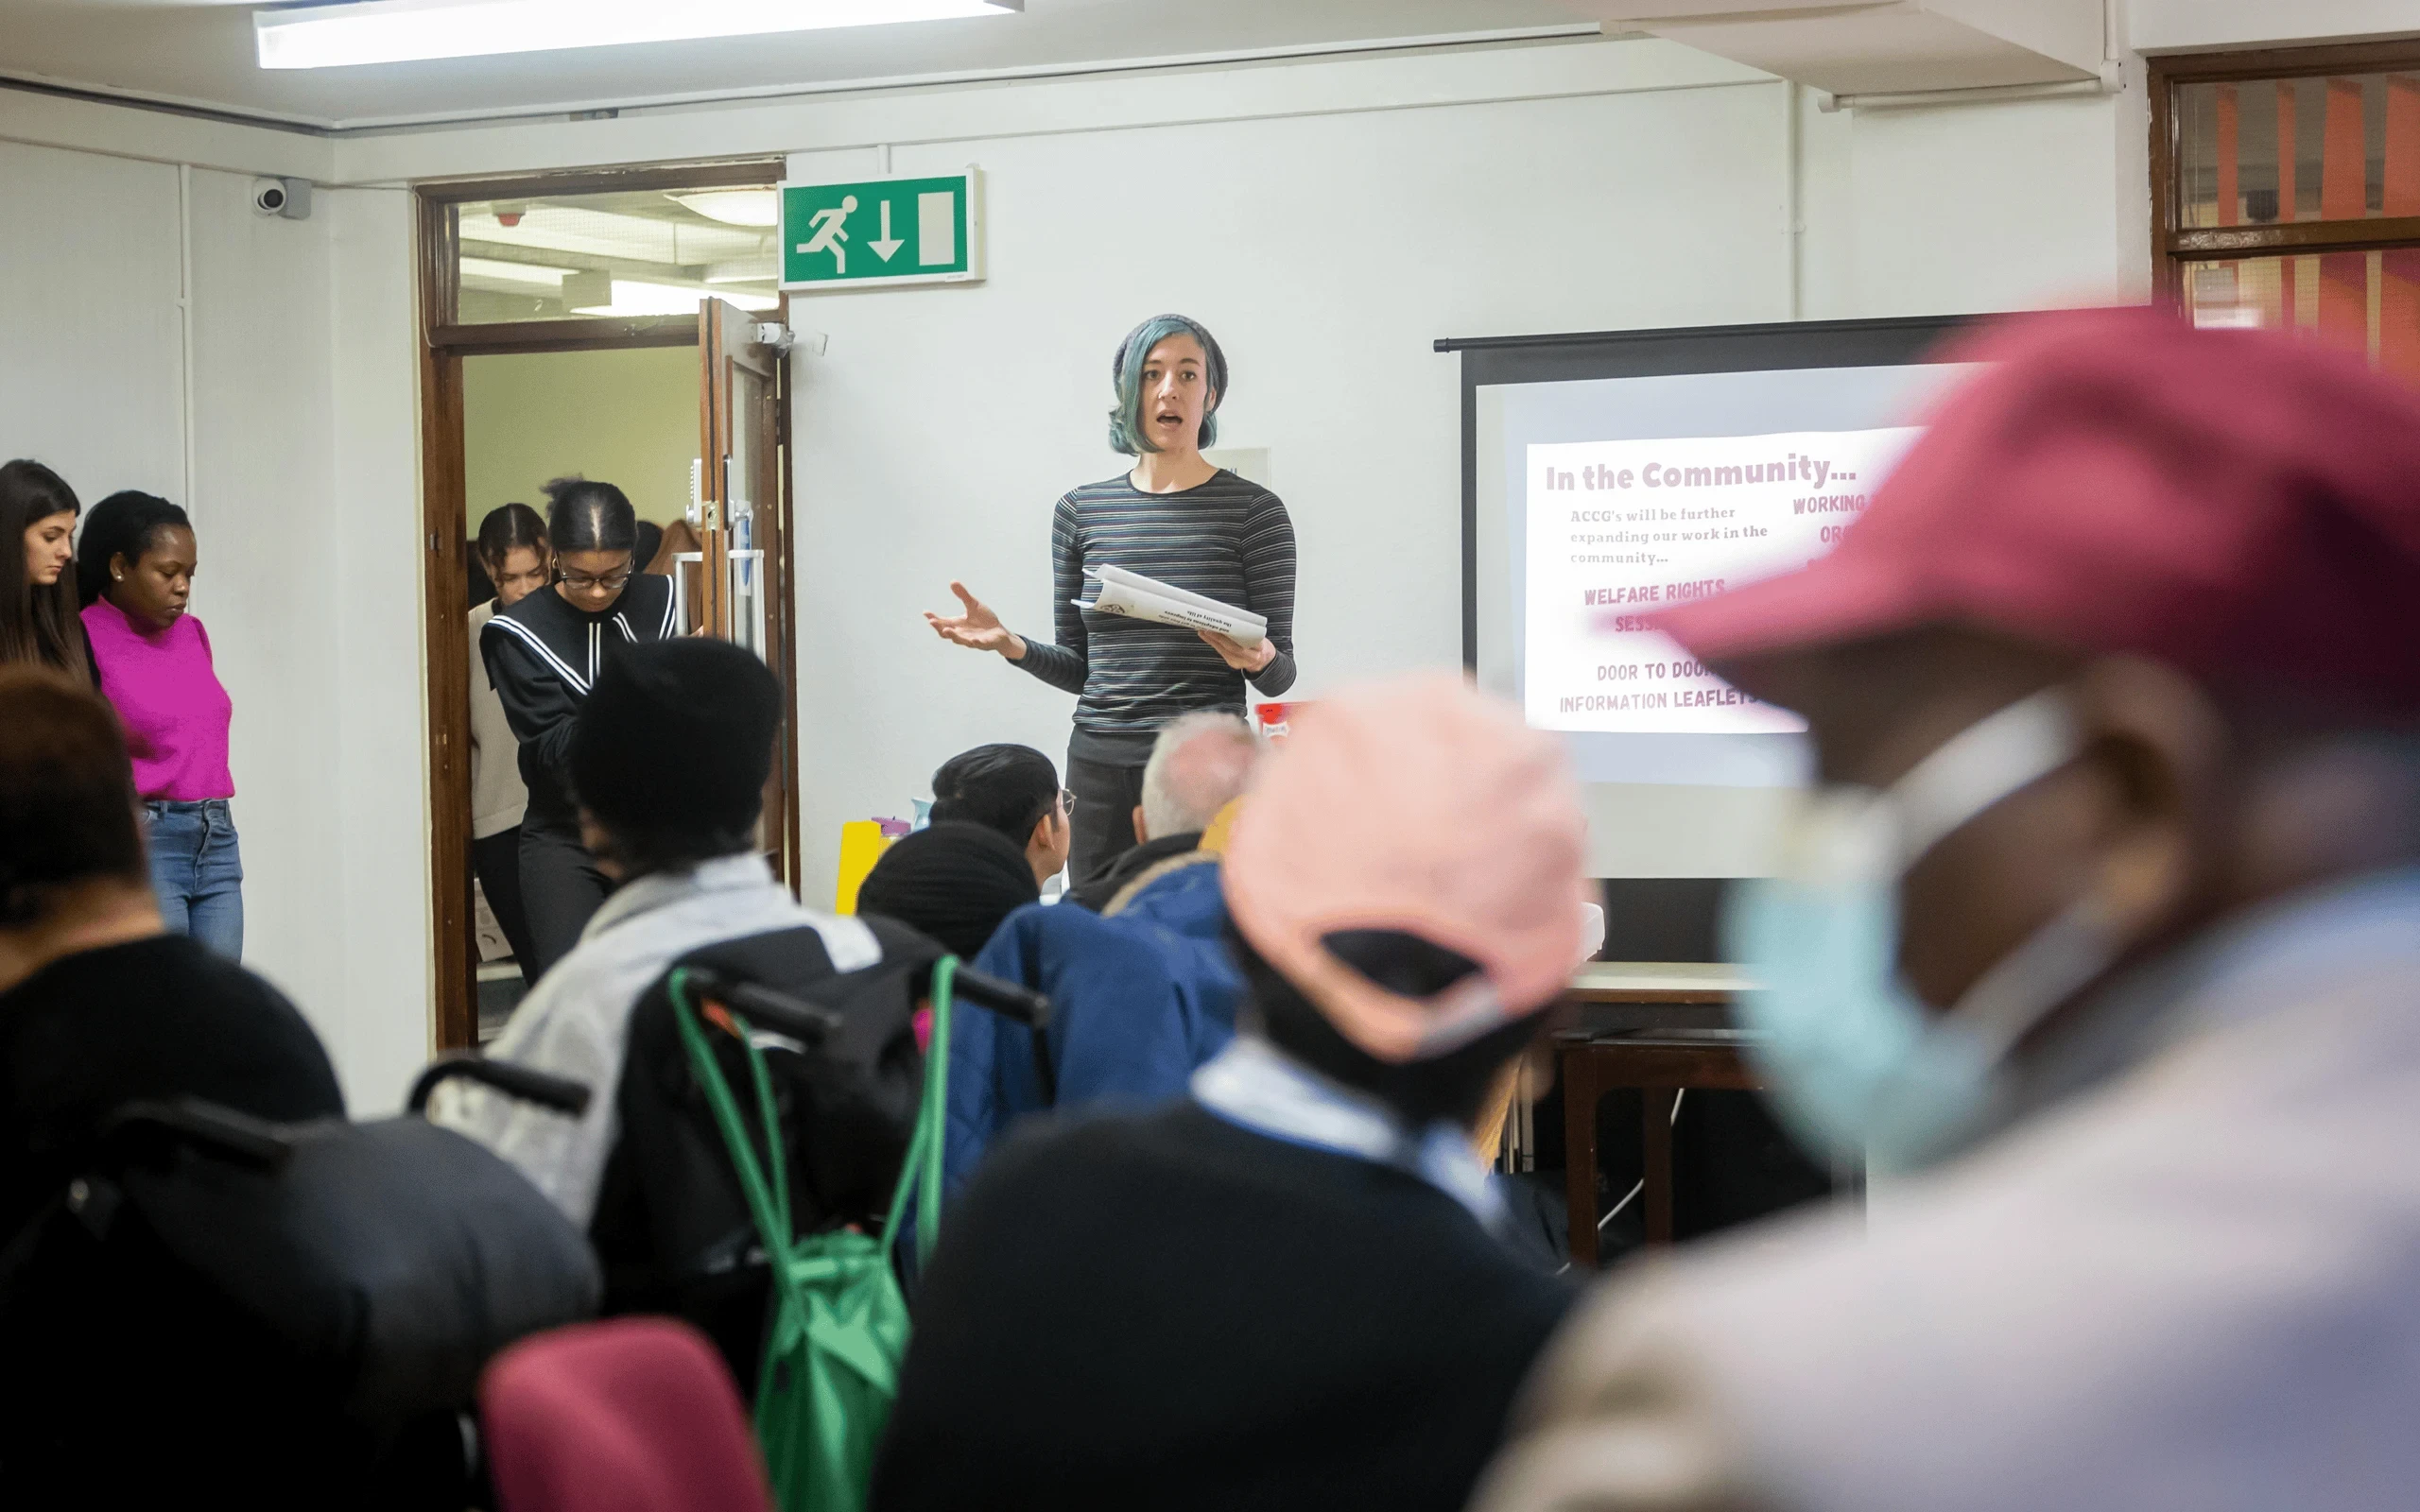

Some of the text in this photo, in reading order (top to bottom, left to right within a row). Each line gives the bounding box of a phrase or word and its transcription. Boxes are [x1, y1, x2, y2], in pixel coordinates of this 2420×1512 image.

[1546, 453, 1857, 490] In the Community...
[1792, 493, 1866, 515] WORKING
[1570, 507, 1736, 523] ACCG's will be further
[1570, 525, 1769, 545] expanding our work in the
[1570, 551, 1669, 565] community...
[1583, 578, 1725, 606] WELFARE RIGHTS
[1597, 661, 1709, 680] DOOR TO DOO
[1560, 693, 1668, 713] INFORMATION
